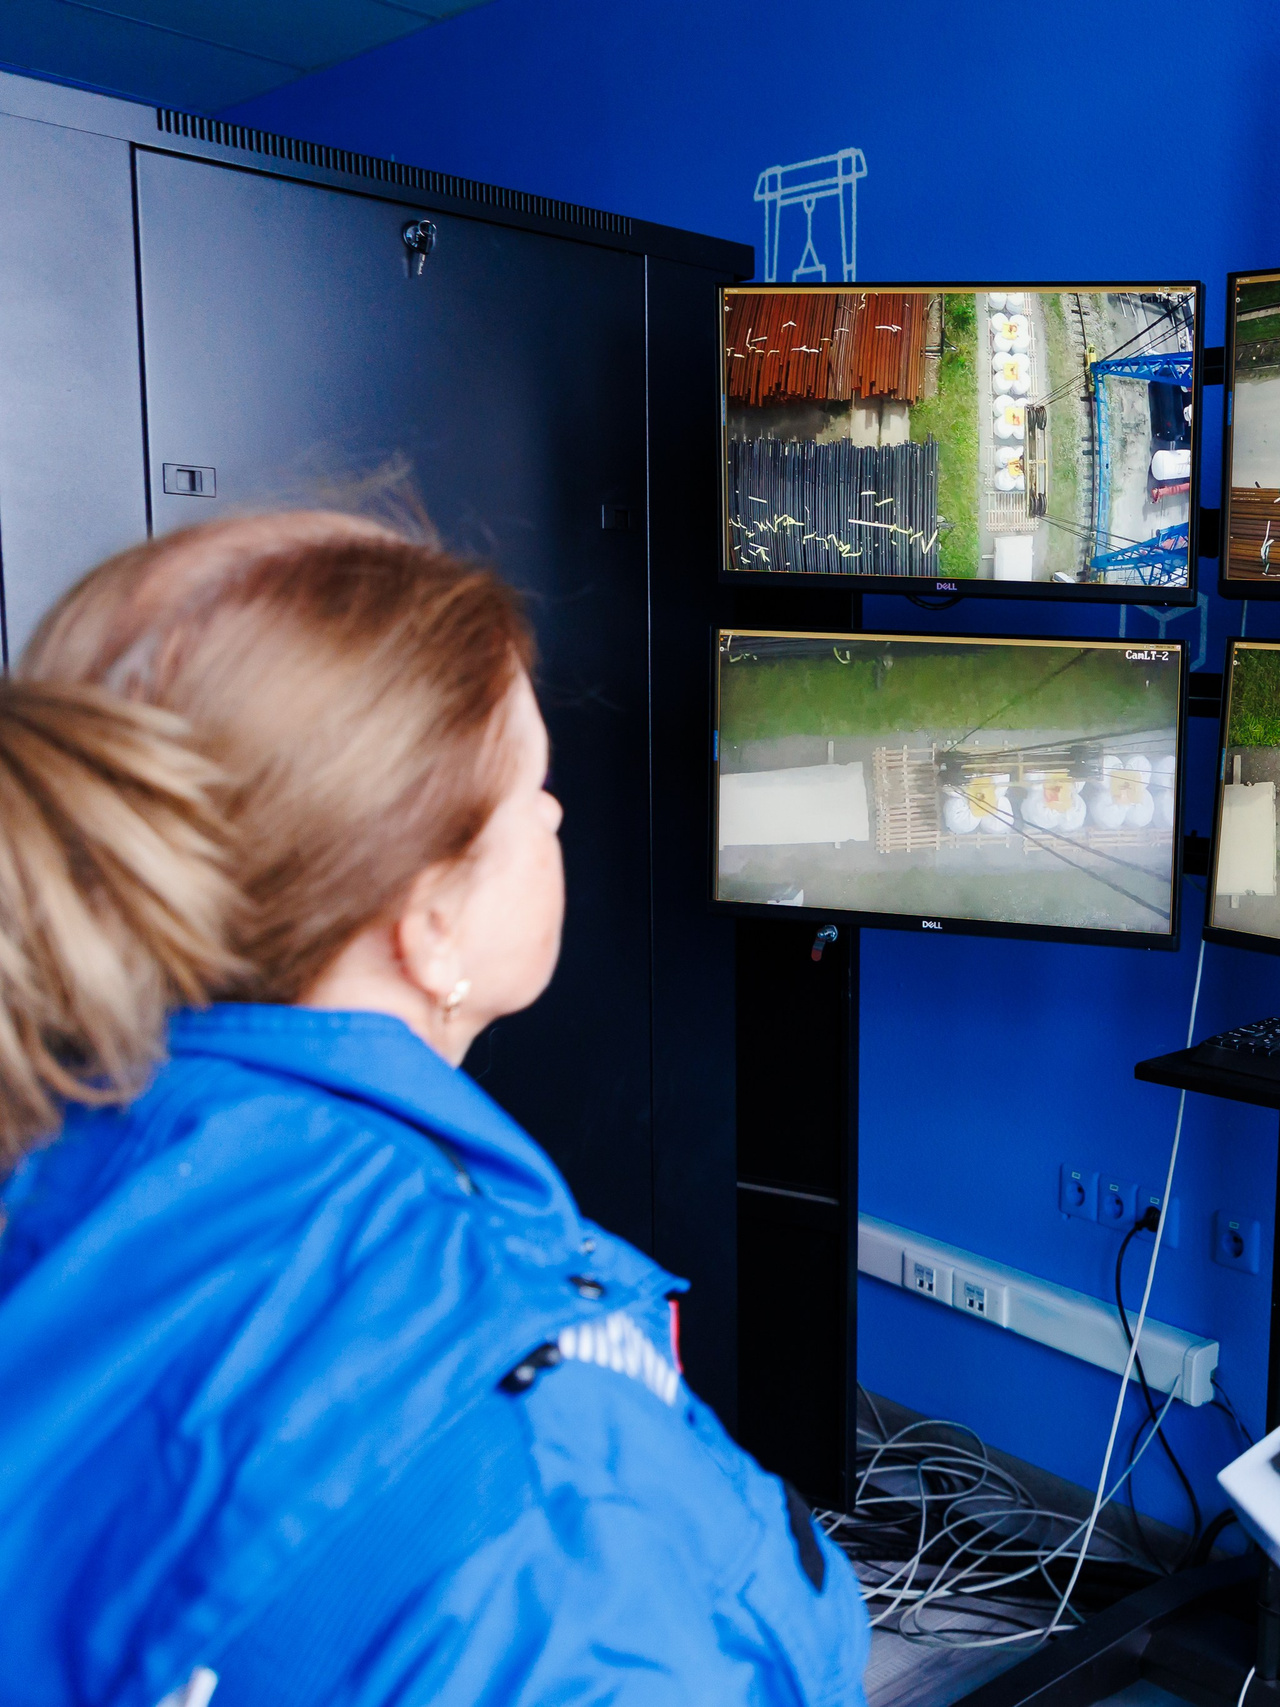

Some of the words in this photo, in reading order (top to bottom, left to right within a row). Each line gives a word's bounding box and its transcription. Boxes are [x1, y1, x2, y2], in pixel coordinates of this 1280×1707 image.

[936, 582, 958, 591] DELL
[1125, 650, 1169, 661] CamLT-2
[922, 920, 943, 930] DELL
